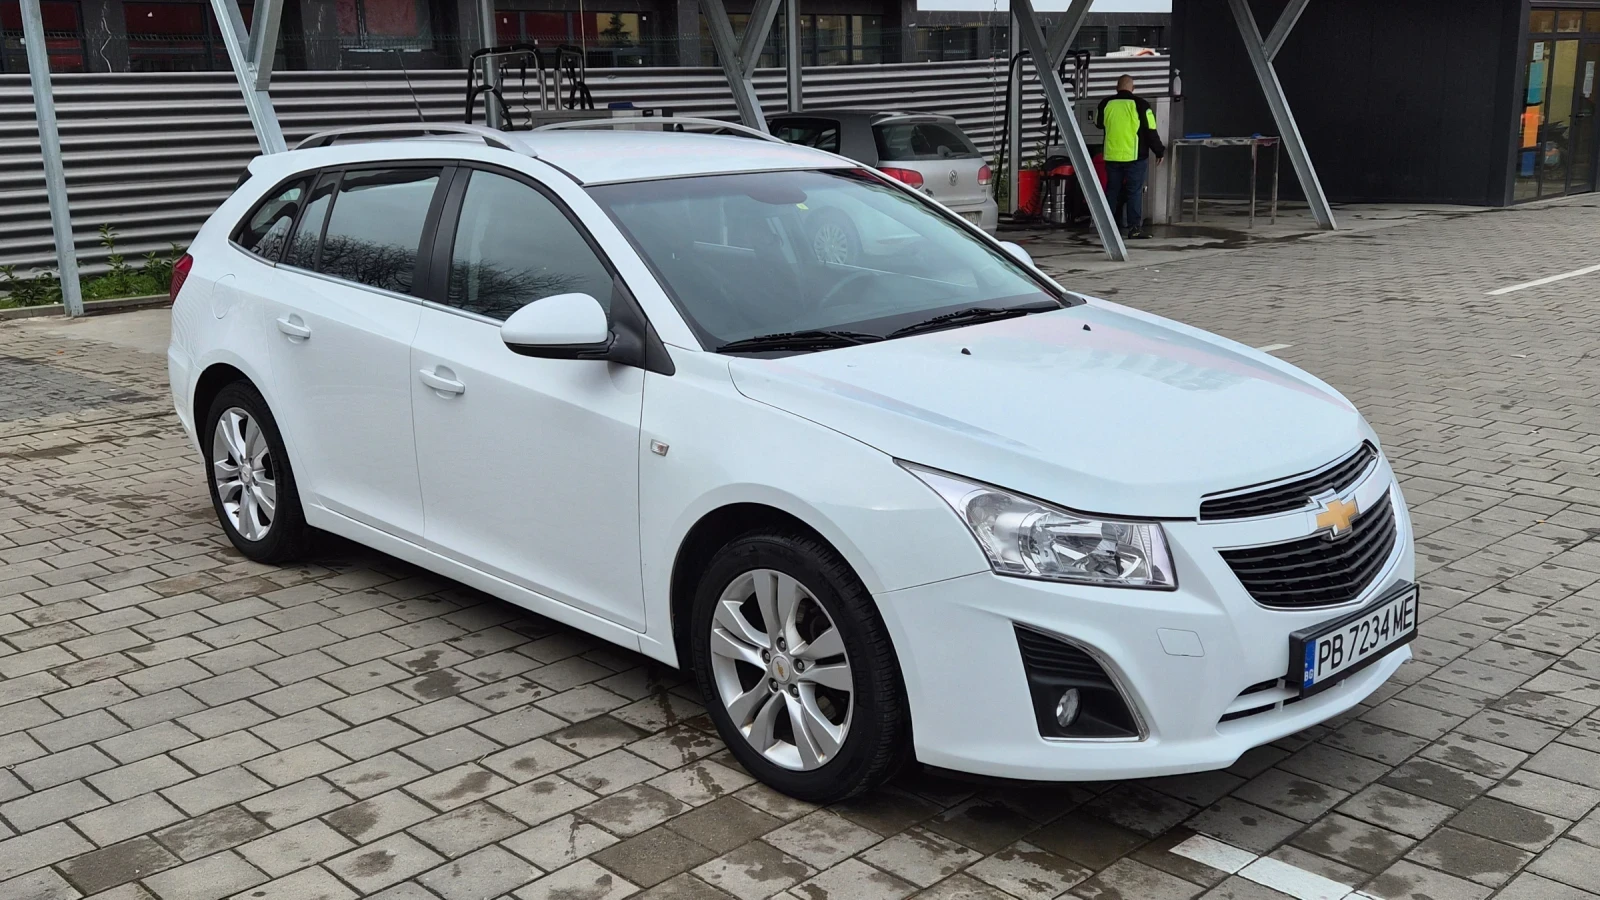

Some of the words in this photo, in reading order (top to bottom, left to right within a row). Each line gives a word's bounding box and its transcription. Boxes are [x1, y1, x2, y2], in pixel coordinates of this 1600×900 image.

[1318, 634, 1344, 676] PB
[1347, 608, 1390, 662] 7234
[1393, 594, 1414, 637] ME
[1304, 669, 1314, 681] BG
